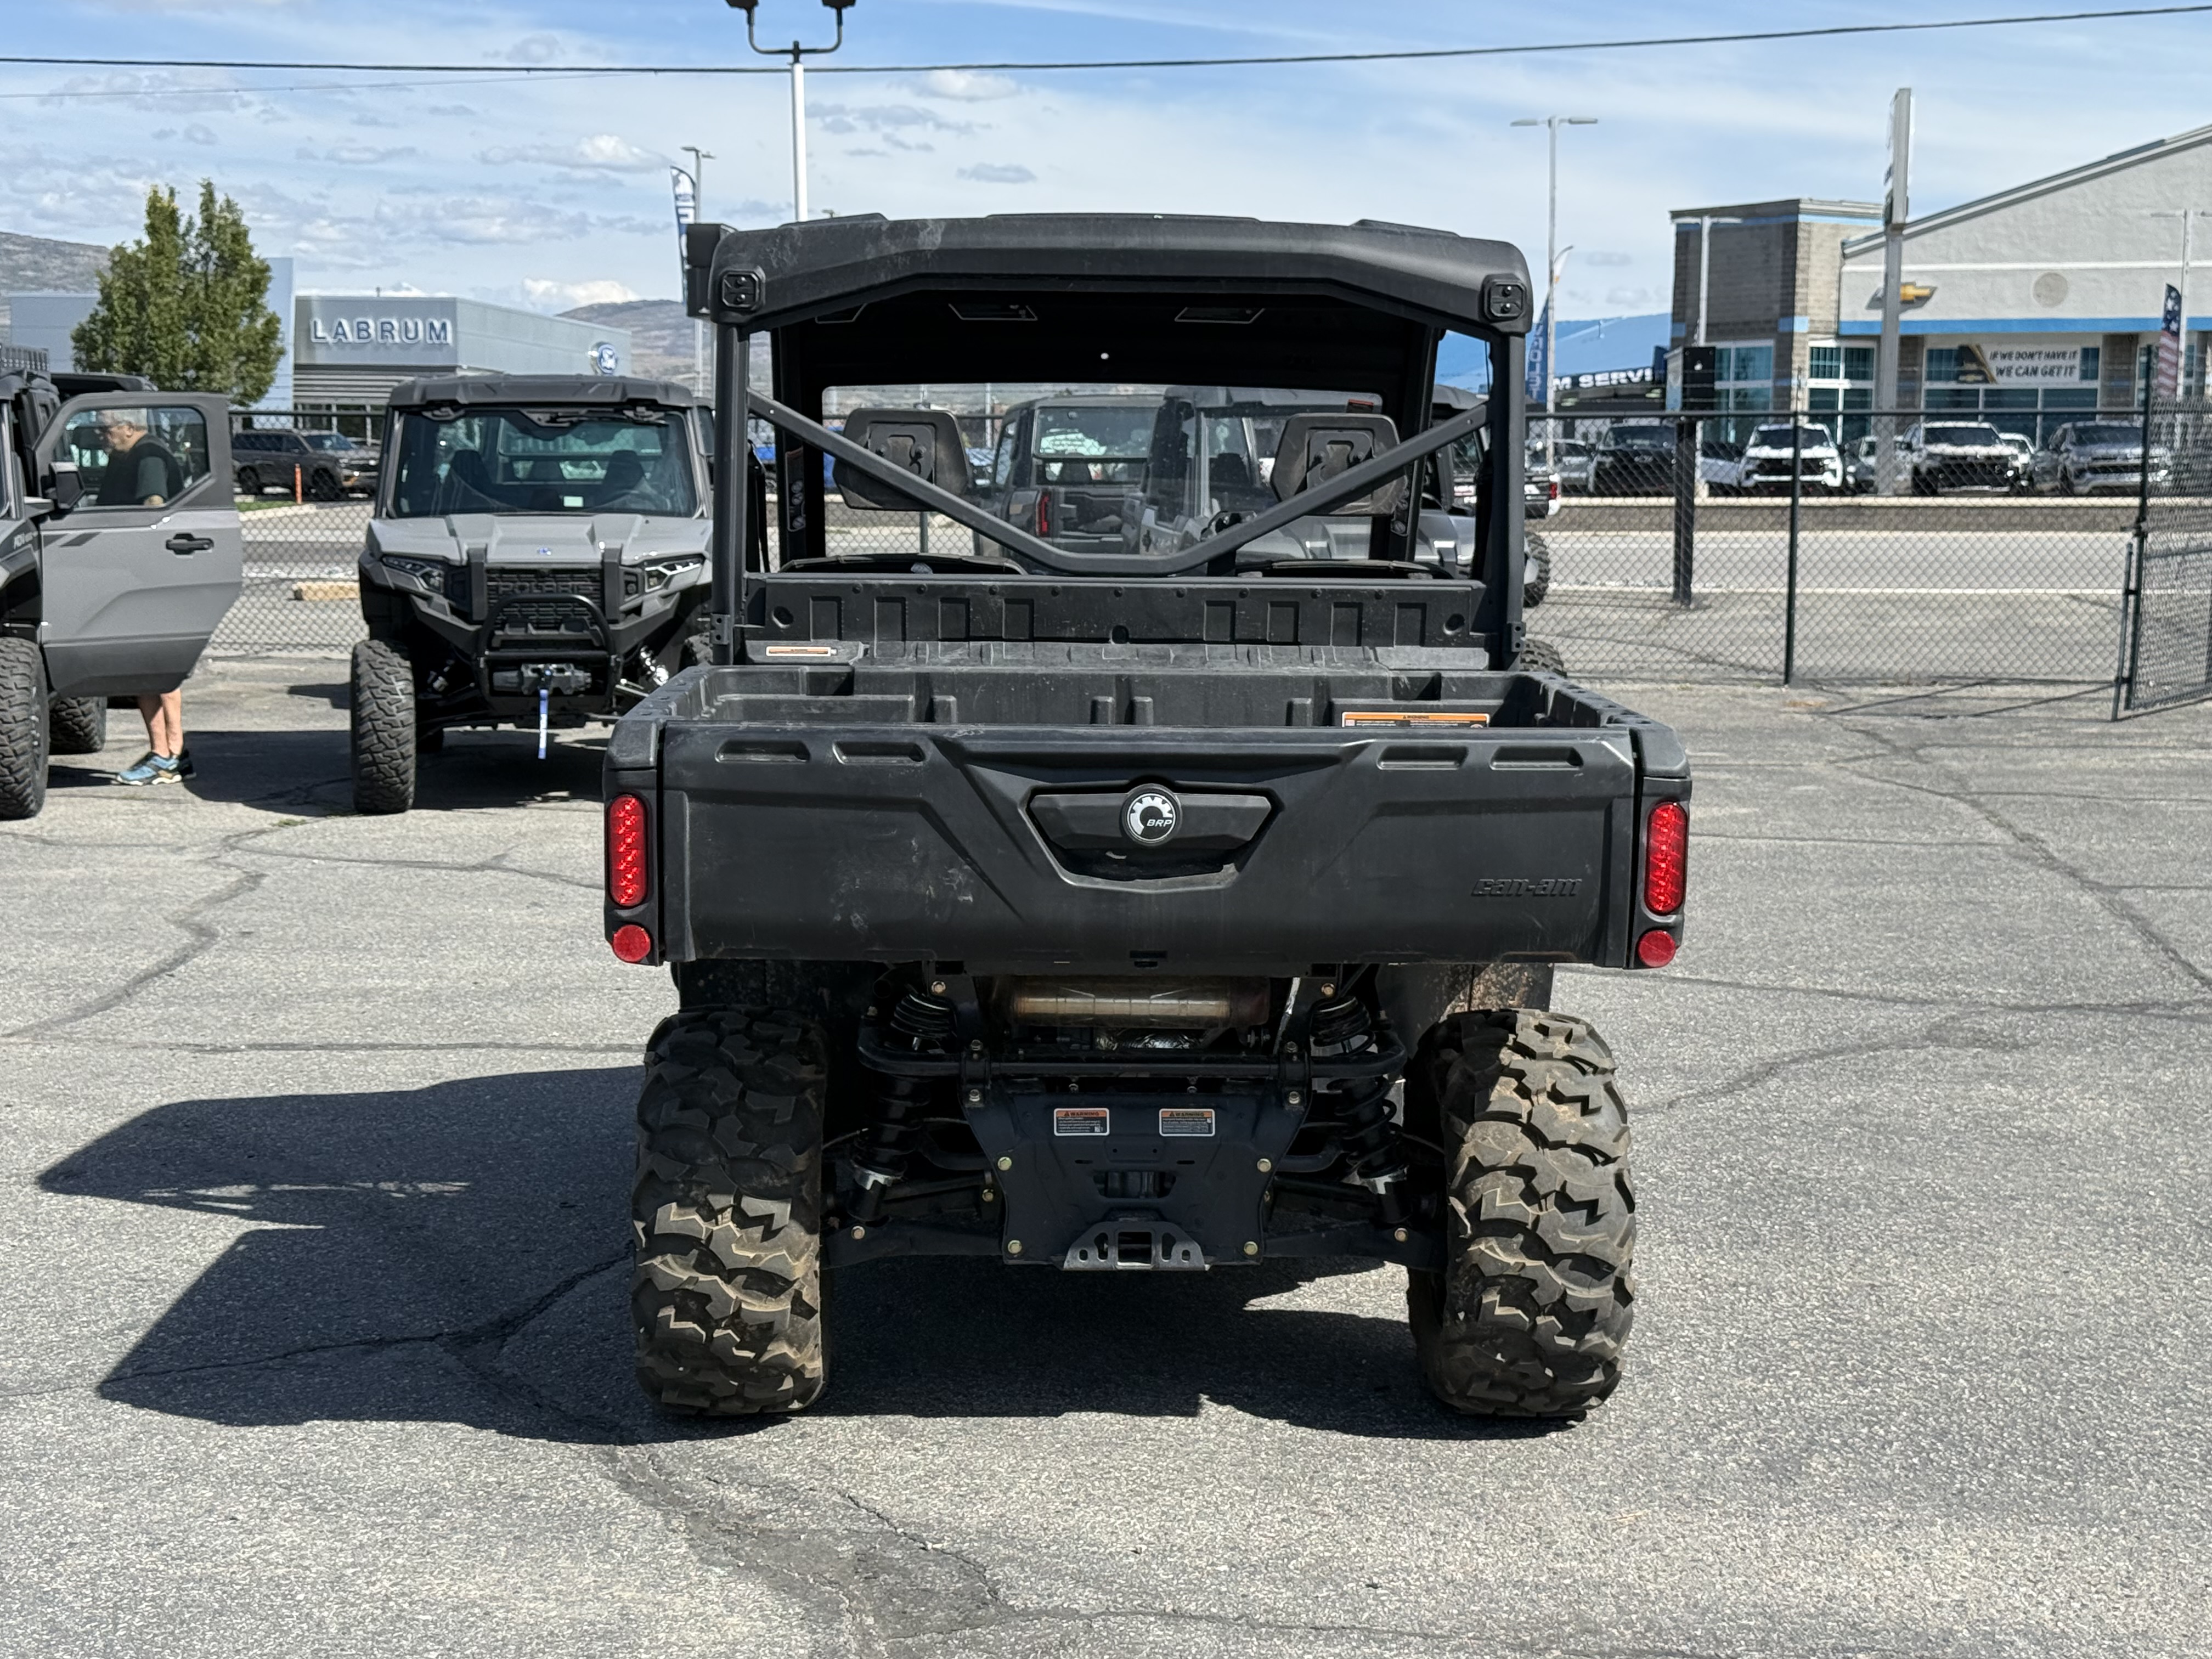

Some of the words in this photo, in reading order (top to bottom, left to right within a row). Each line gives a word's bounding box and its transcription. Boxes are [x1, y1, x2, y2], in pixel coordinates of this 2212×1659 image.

[311, 318, 452, 343] LABRUM
[1989, 351, 1999, 360] IF
[2000, 351, 2014, 360] WE
[2015, 351, 2043, 360] DON'T
[2044, 351, 2067, 360] HAVE
[2068, 350, 2078, 360] IT
[1995, 365, 2013, 377] WE
[2015, 365, 2039, 377] CAN
[2040, 365, 2063, 377] GET
[2063, 365, 2076, 377] IT
